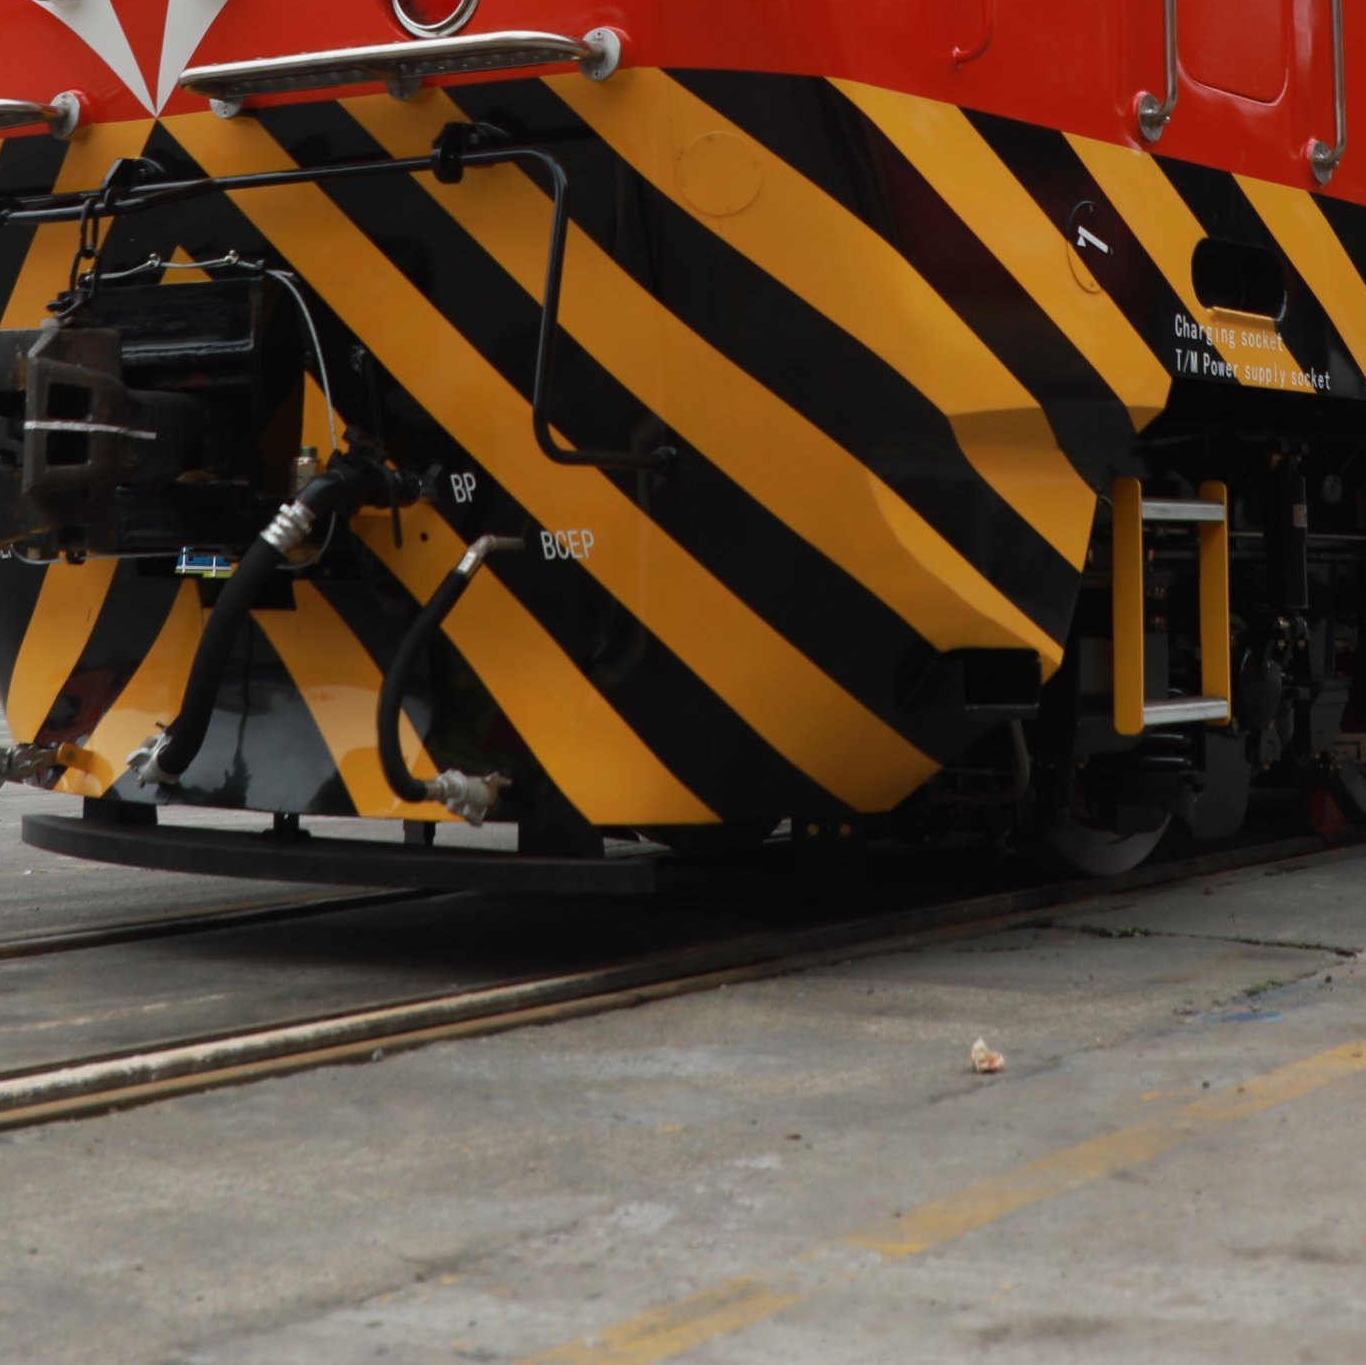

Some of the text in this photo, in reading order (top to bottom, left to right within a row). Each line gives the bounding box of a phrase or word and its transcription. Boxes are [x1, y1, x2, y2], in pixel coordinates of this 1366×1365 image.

[1174, 313, 1284, 351] Charging socket
[1175, 348, 1331, 390] T/M Power supply socket
[450, 472, 476, 503] BP
[540, 530, 595, 560] BCEP
